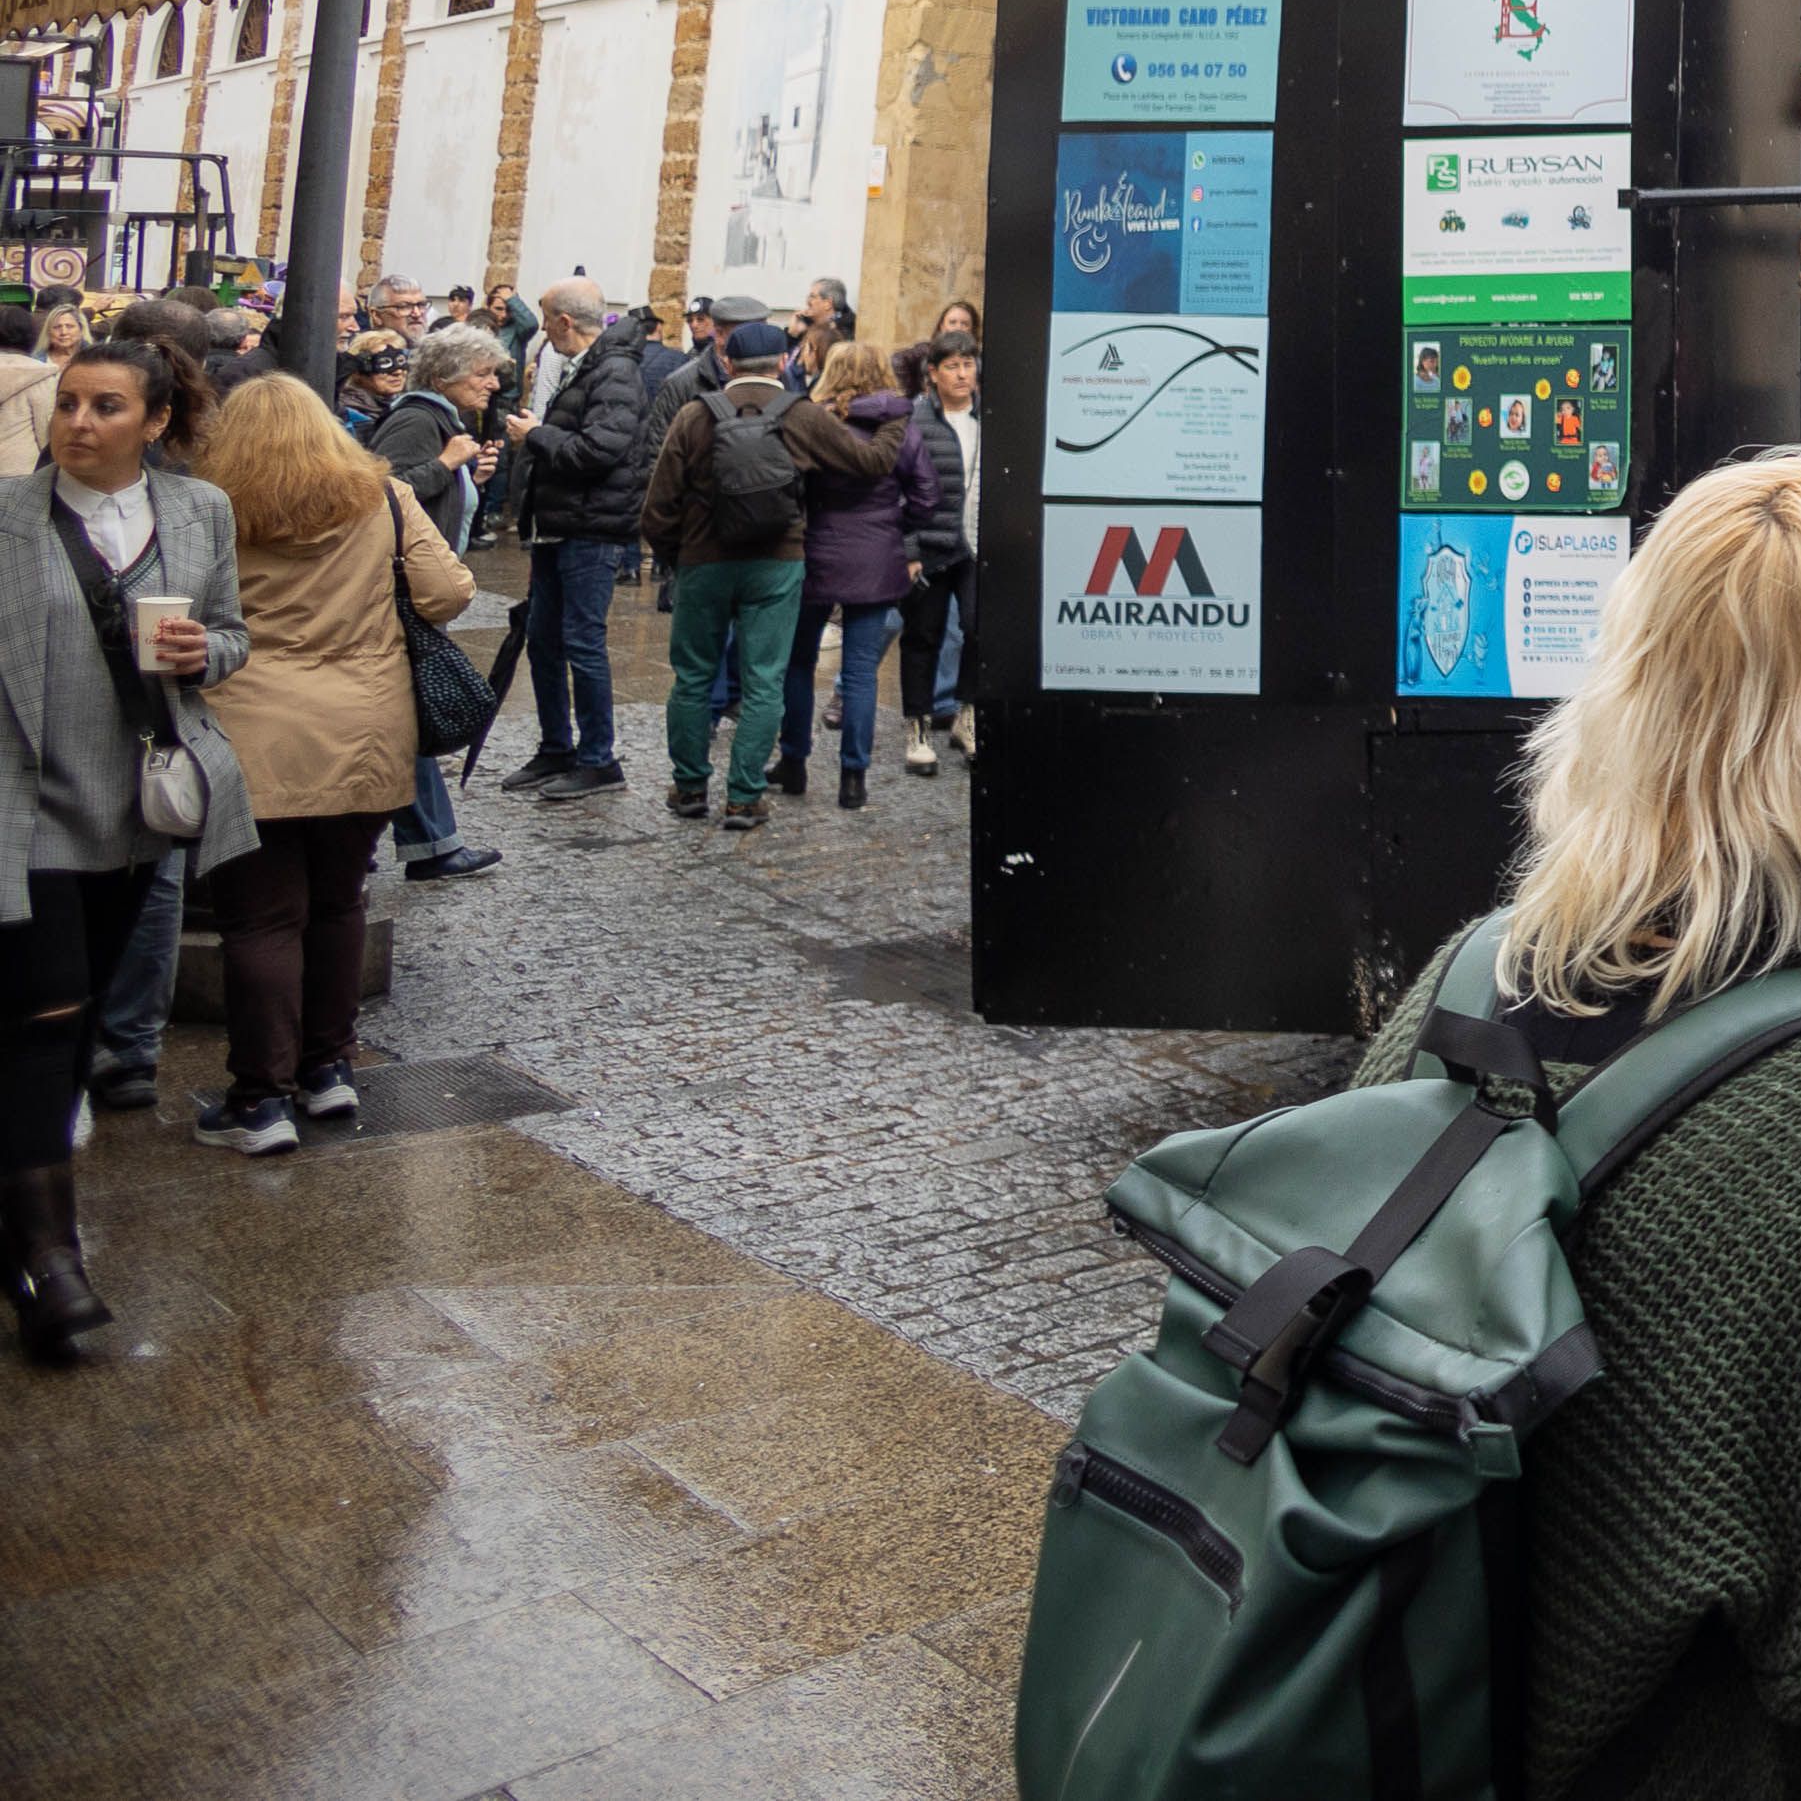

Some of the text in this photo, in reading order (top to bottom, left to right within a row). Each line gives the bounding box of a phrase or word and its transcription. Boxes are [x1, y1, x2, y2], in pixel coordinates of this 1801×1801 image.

[1086, 3, 1267, 26] VICTORIANO CANO PÉREZ
[1148, 63, 1247, 78] 956 94 07 50
[1467, 155, 1603, 175] RUBYSAN
[1459, 334, 1497, 347] PROYECTO
[1534, 535, 1617, 551] ISLAPLAGAS
[1057, 601, 1250, 628] MAIRANDU
[1081, 629, 1225, 643] OBRAS Y PROYECTOS
